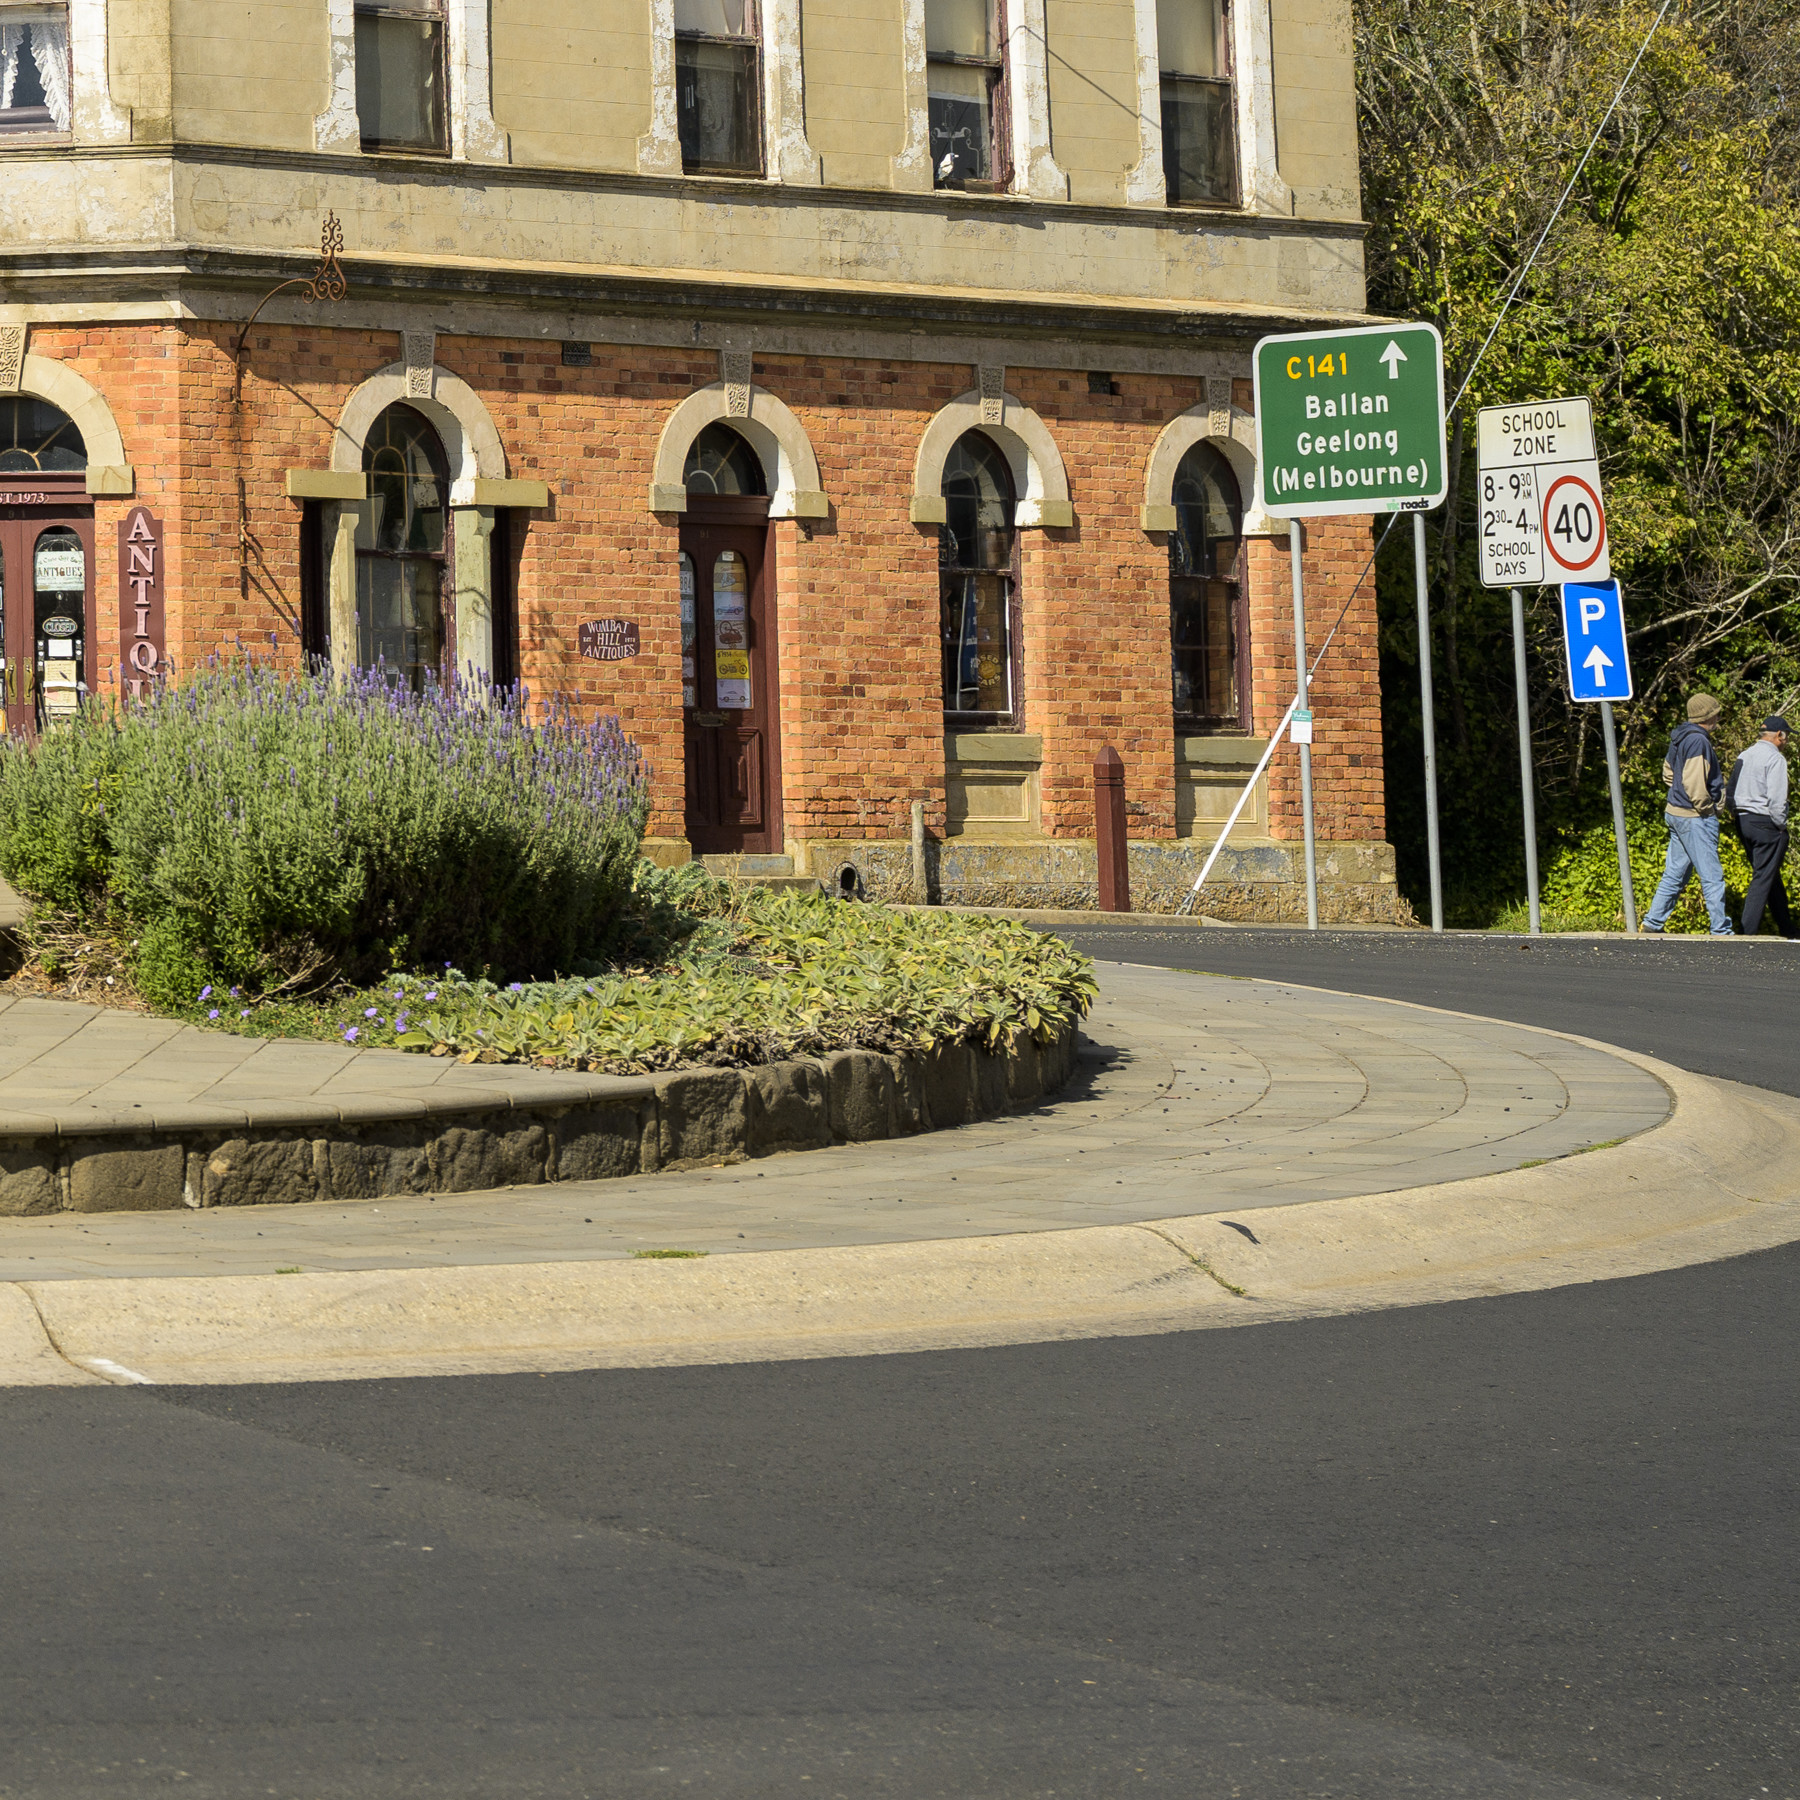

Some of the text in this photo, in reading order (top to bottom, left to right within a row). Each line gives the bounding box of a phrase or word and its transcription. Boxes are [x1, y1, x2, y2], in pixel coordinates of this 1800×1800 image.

[1286, 352, 1348, 380] C141
[1305, 392, 1389, 419] Ballan
[1502, 409, 1566, 434] SCHOOL
[1297, 429, 1398, 456] Geelong
[1513, 434, 1557, 457] ZONE
[1272, 458, 1428, 496] (Melbourne)
[17, 492, 45, 504] 1973
[1553, 502, 1593, 544] 40
[1488, 541, 1536, 558] SCHOOL
[1495, 561, 1527, 577] DAYS
[45, 621, 76, 633] CLOSED
[1579, 597, 1606, 635] P
[597, 632, 621, 646] HILL
[583, 644, 636, 660] ANTIQUES
